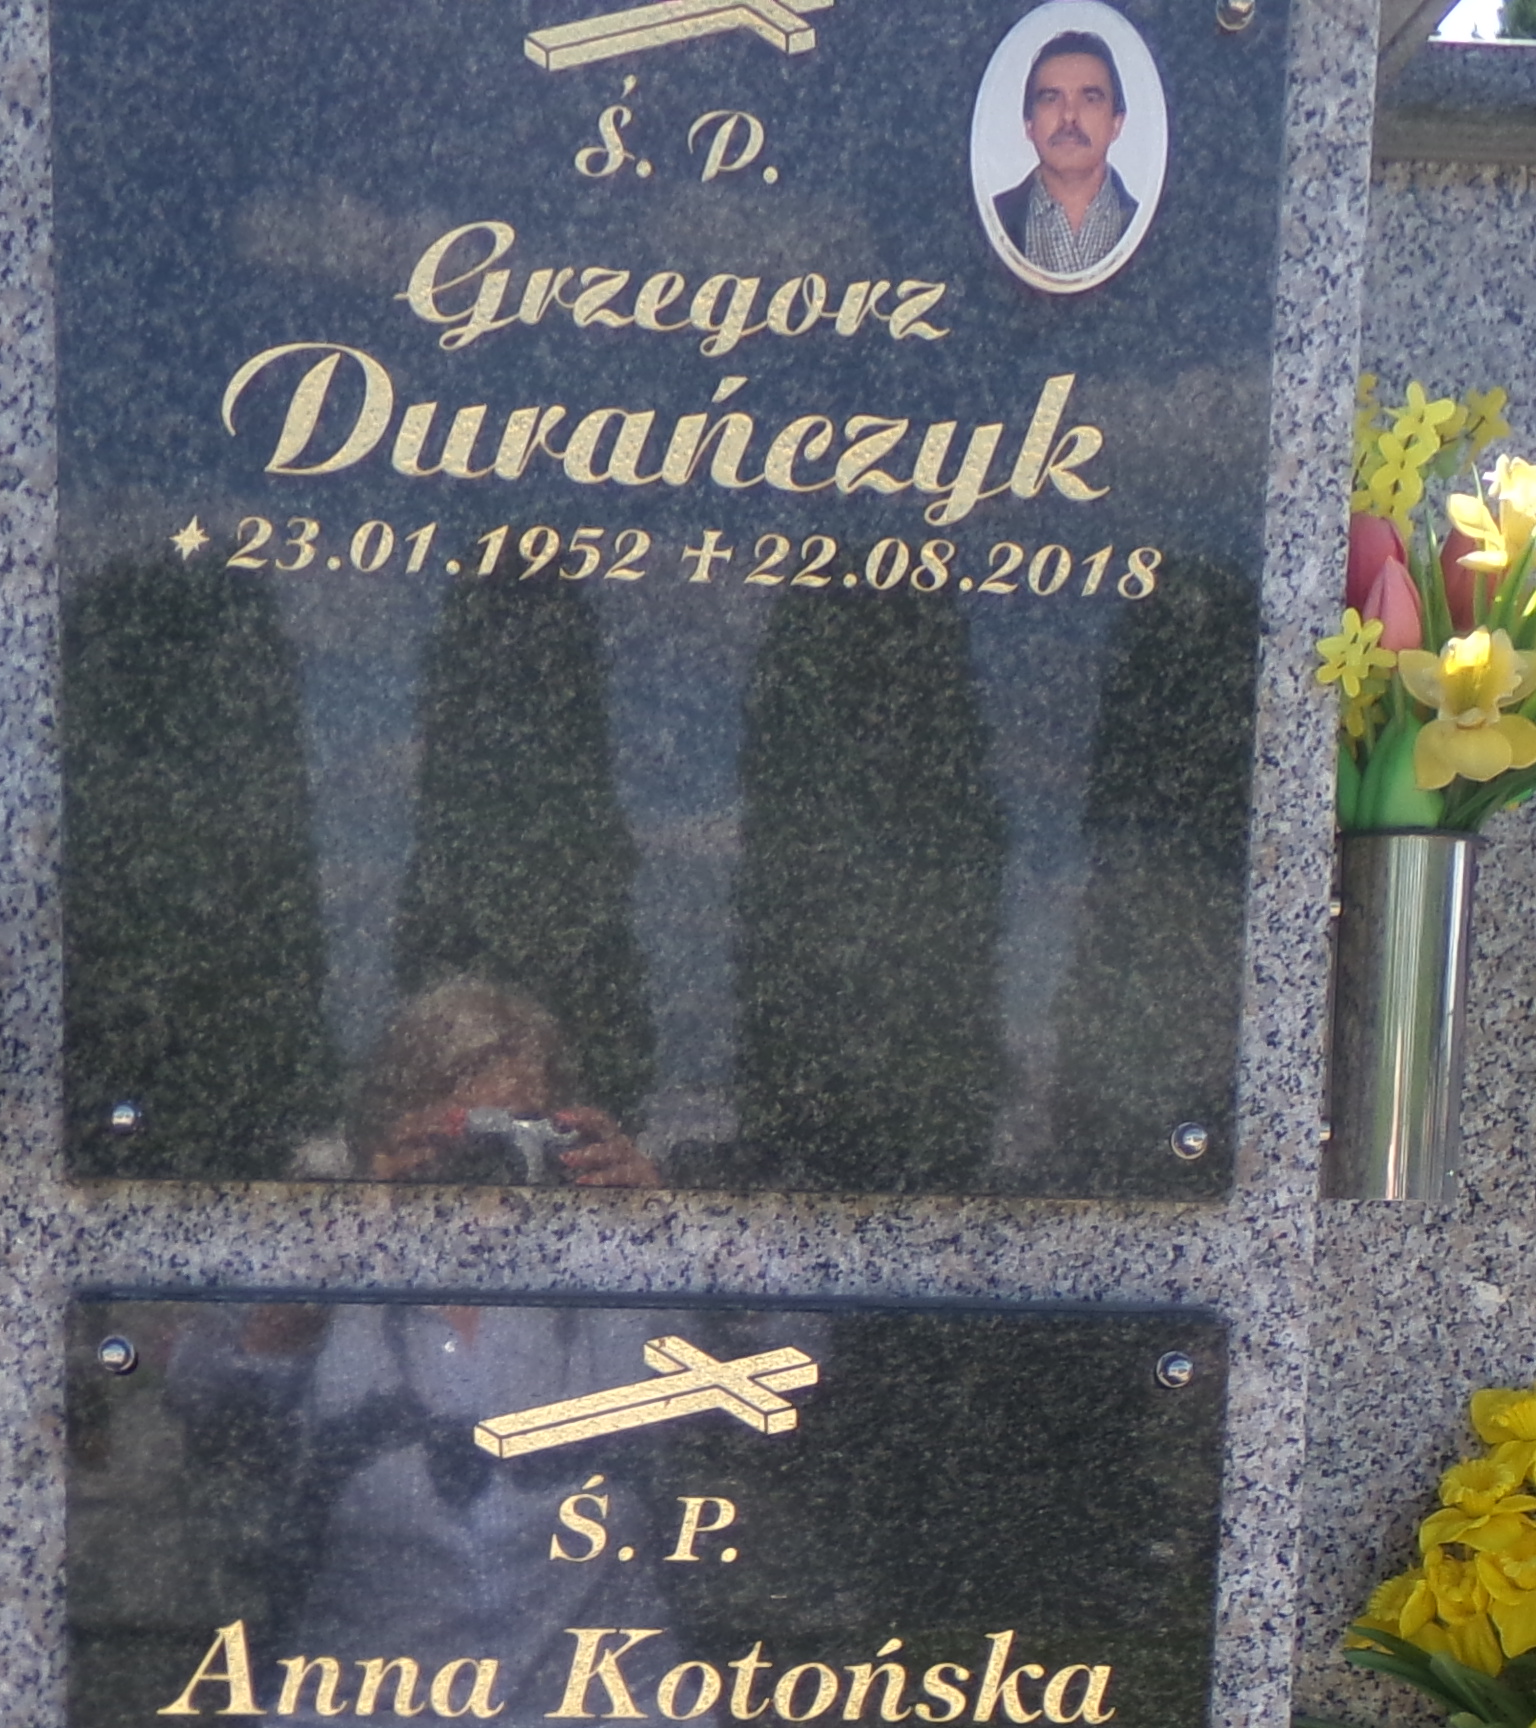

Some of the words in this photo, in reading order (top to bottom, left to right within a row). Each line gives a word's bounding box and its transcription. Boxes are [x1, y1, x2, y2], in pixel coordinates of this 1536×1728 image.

[573, 75, 653, 179] Ś.
[687, 109, 780, 184] P.
[394, 220, 950, 357] Grzegorz
[221, 342, 1110, 524] Durańczyk
[225, 514, 649, 583] 23.01.1952
[744, 532, 1163, 599] 22.08.2018
[549, 1474, 635, 1564] Ś.
[665, 1495, 740, 1564] P.
[157, 1618, 505, 1721] Anna
[544, 1626, 1117, 1725] Kotońska
